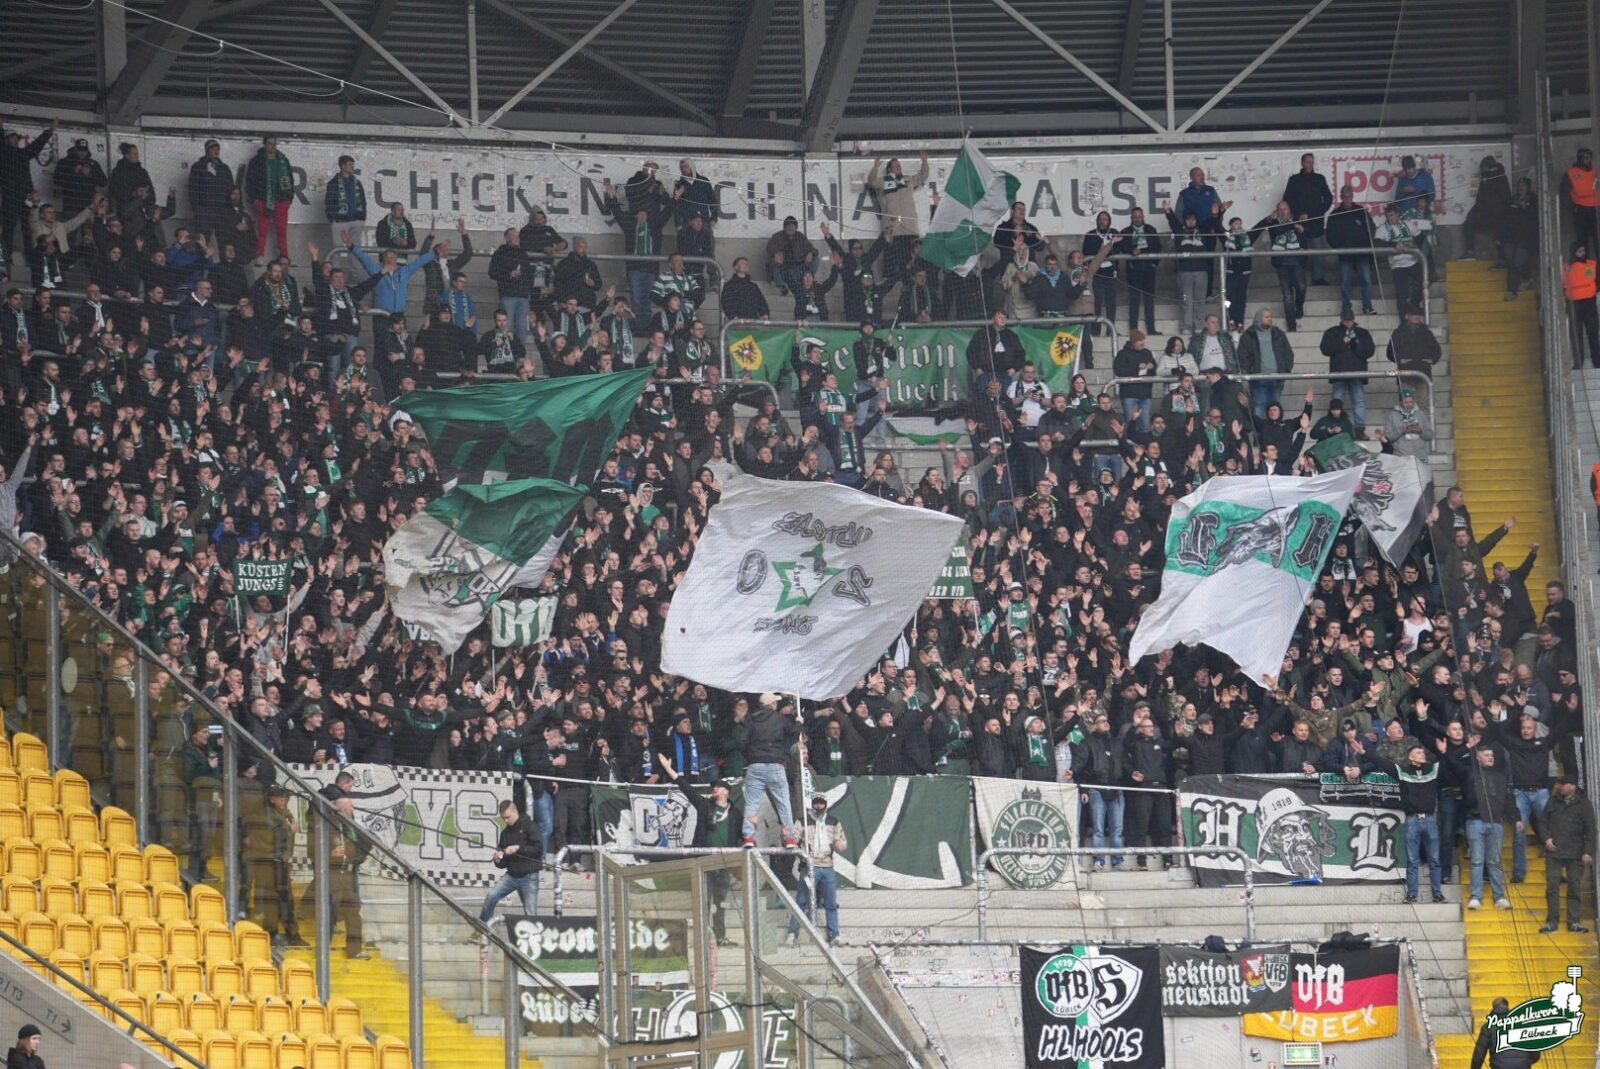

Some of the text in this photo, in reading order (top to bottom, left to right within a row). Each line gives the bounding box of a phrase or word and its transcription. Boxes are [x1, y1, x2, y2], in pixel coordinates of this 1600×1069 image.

[353, 168, 613, 215] CHICKEN
[1029, 176, 1171, 218] AUSE
[238, 562, 287, 577] KÜSTEN
[238, 578, 277, 591] JUNGS
[11, 985, 58, 1024] T3 T1
[1295, 963, 1345, 1010] VfB
[1038, 1024, 1143, 1063] HL HOOLS
